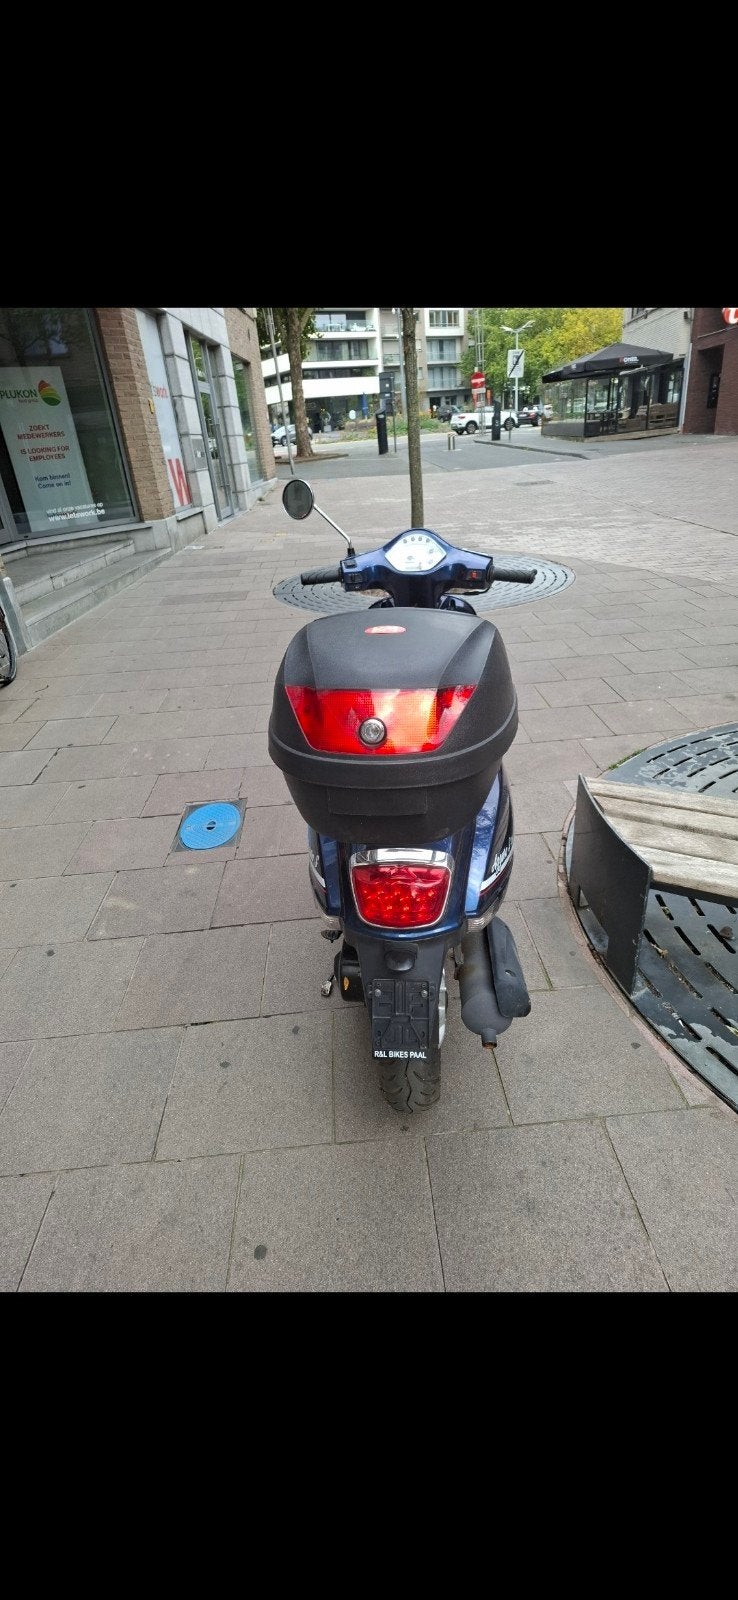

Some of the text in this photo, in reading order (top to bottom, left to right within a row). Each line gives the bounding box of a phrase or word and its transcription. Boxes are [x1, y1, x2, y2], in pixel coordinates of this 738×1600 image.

[0, 389, 38, 399] PLUKON
[17, 431, 65, 439] MEDEWERKERS
[28, 446, 56, 454] LOOKING
[48, 508, 105, 521] www.letswork.be
[374, 1050, 427, 1059] R&L BIKES PAAL
